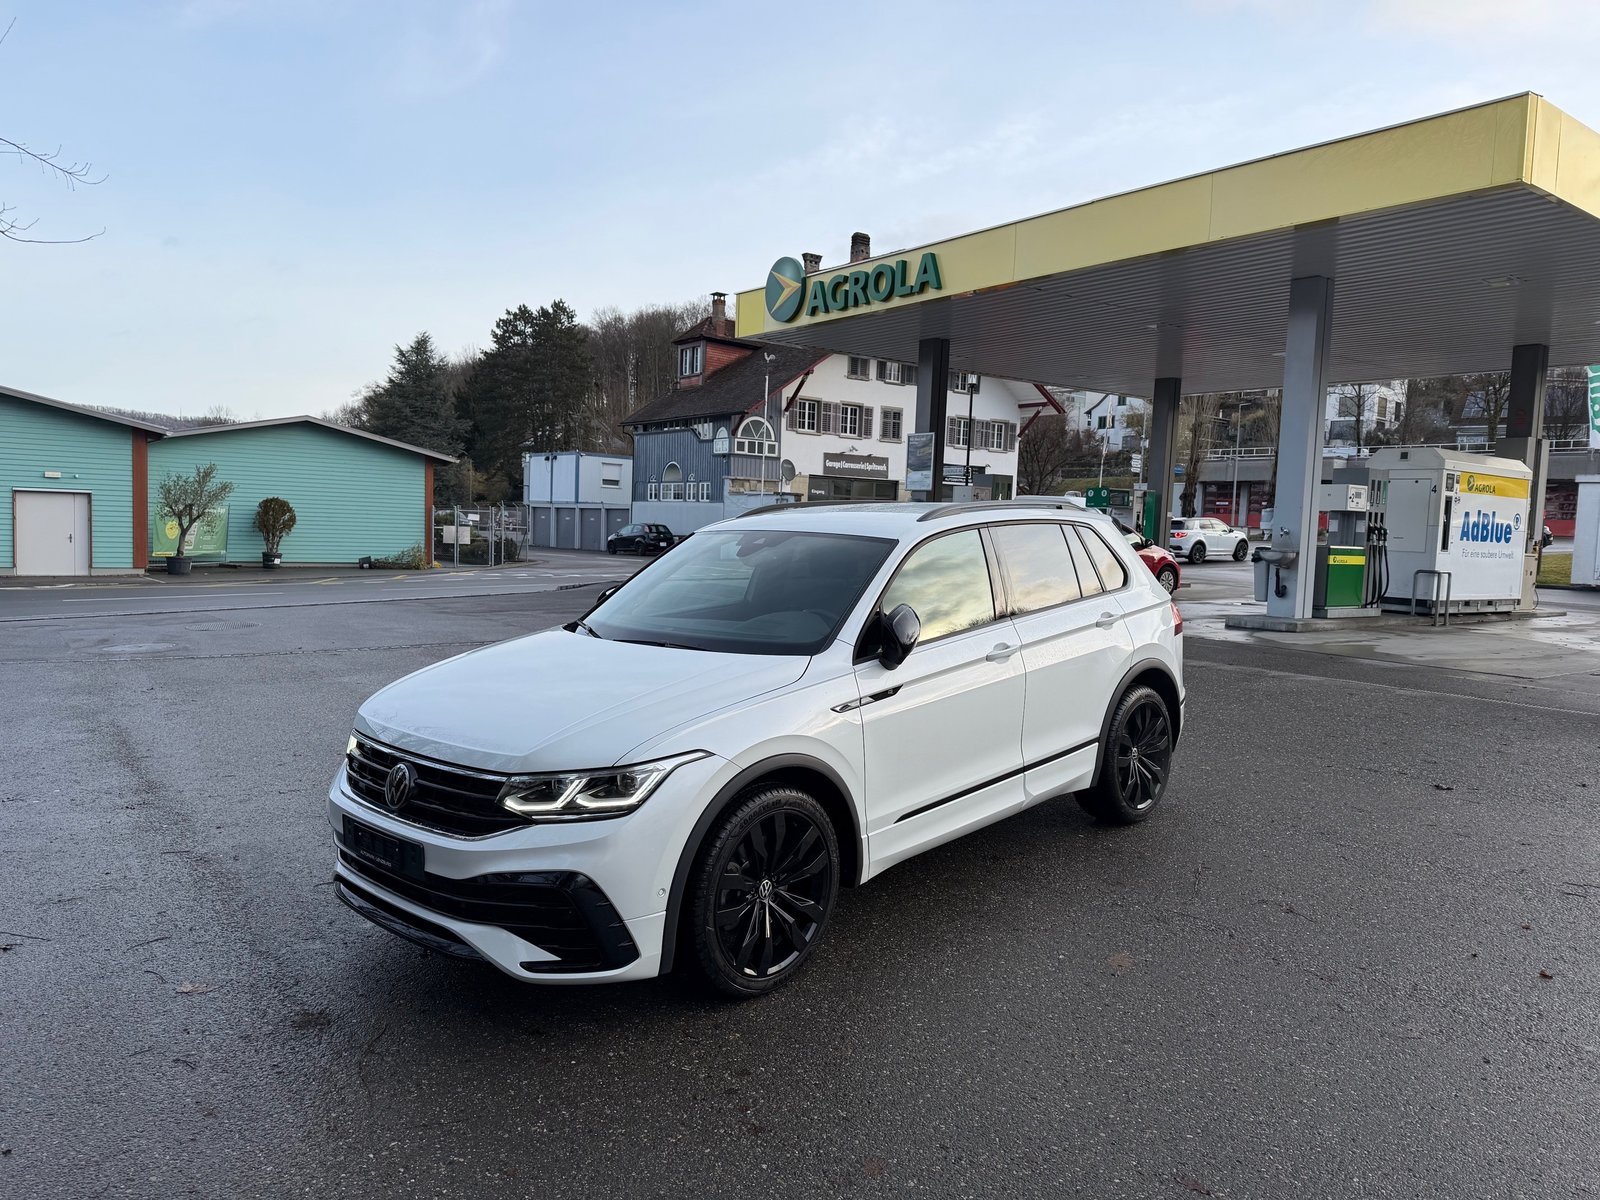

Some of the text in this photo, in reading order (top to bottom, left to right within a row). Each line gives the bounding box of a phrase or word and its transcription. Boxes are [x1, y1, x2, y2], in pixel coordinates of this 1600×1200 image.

[805, 252, 942, 317] AGROLA
[825, 459, 841, 469] Garage
[1432, 485, 1437, 494] 4
[1474, 483, 1496, 494] AGROLA
[1462, 548, 1470, 558] Für
[1470, 549, 1480, 558] eine
[1480, 549, 1497, 559] saubere
